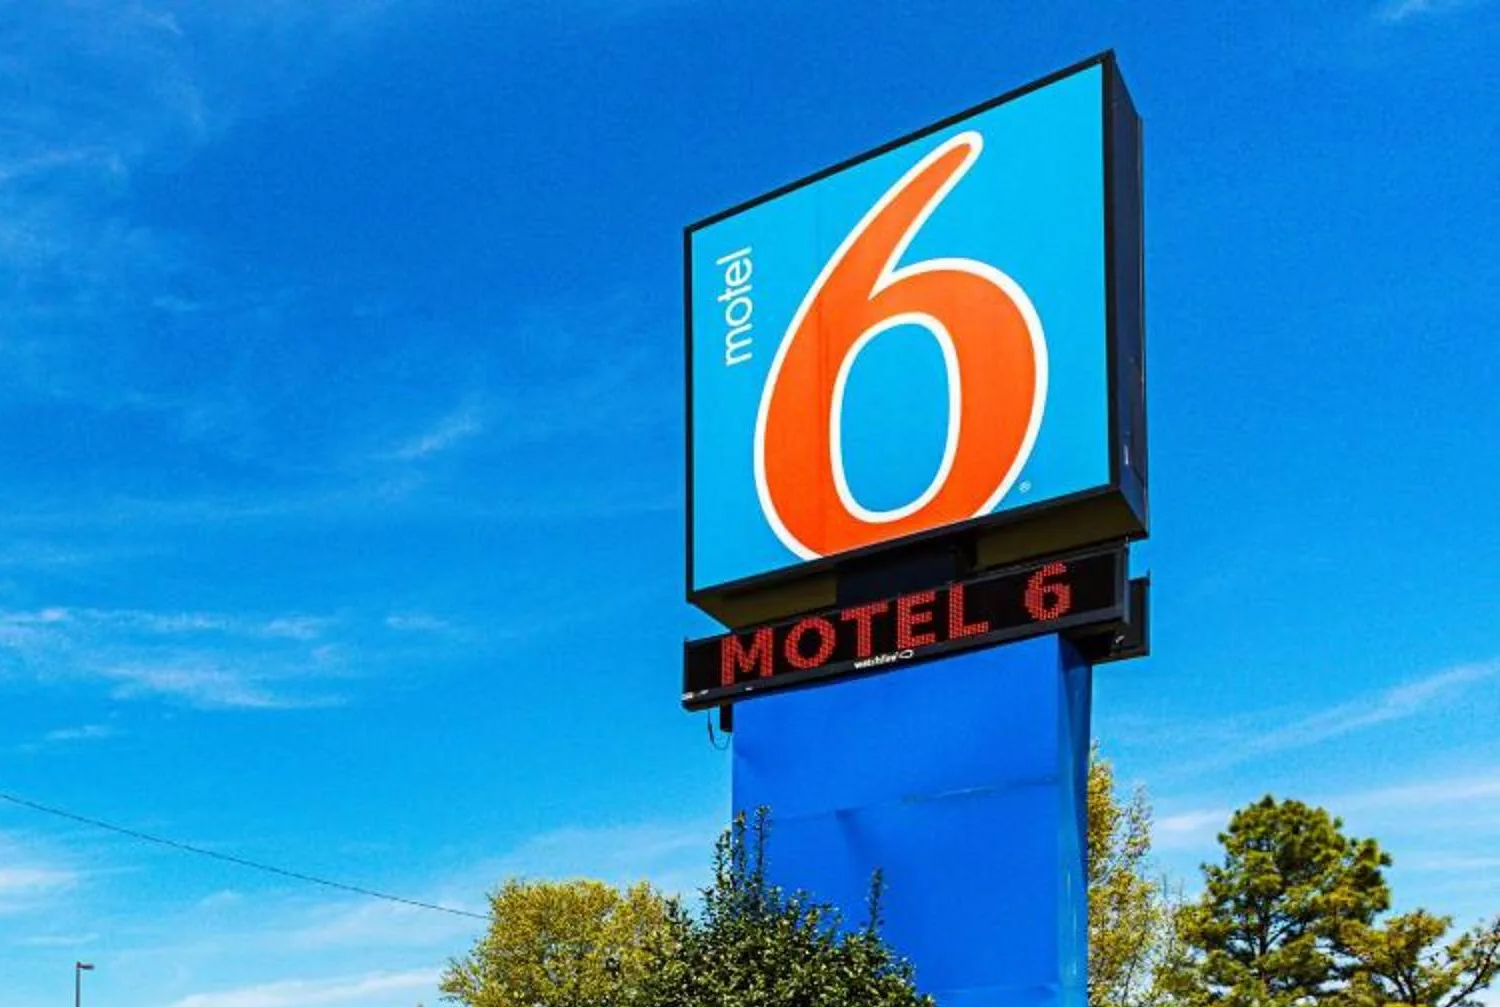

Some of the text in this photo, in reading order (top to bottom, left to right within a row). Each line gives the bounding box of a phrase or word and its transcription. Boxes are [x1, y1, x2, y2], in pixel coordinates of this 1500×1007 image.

[715, 246, 753, 367] motel
[753, 130, 1049, 562] 6
[720, 560, 1074, 689] MOTEL 6
